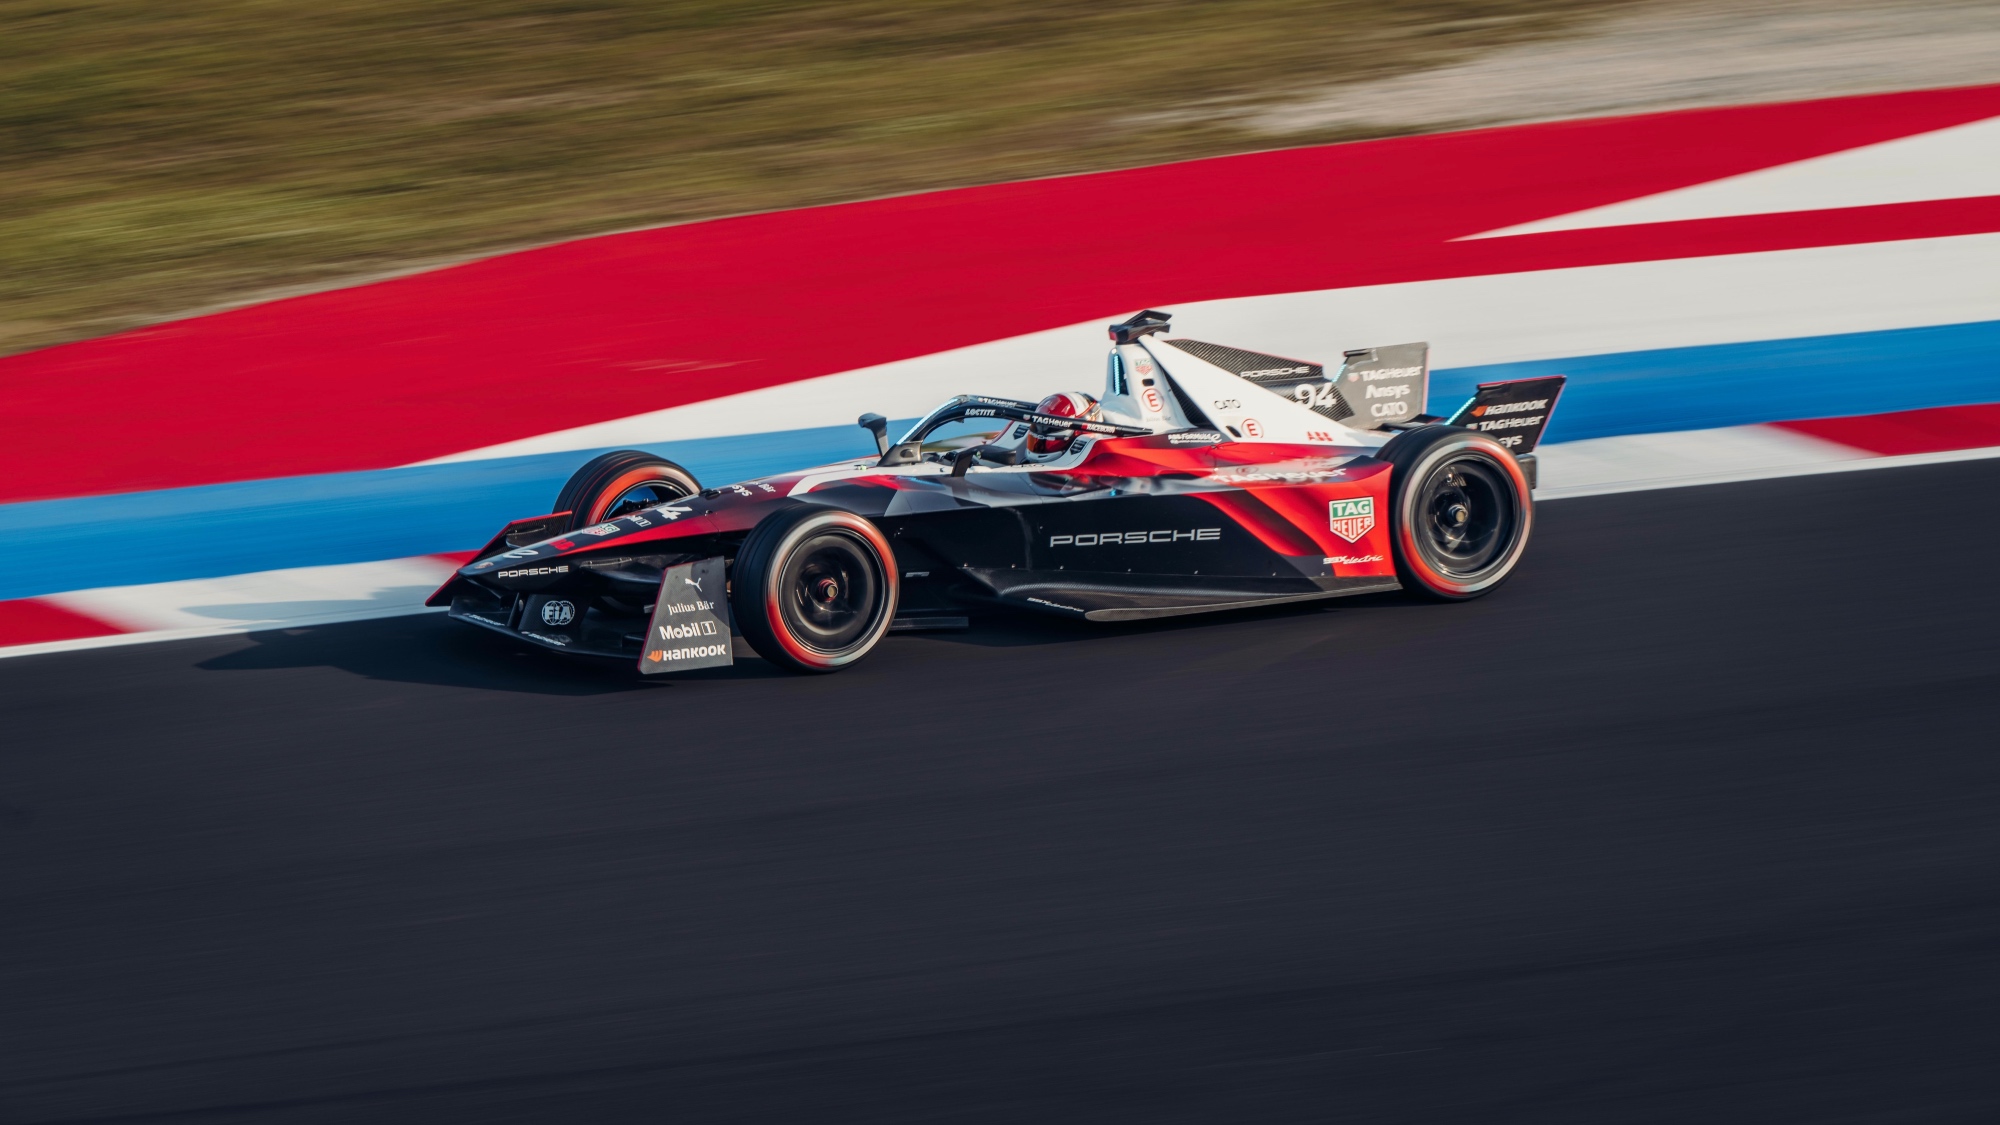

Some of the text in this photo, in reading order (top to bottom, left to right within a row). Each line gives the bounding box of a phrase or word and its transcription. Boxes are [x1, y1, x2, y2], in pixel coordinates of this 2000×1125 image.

[1240, 366, 1309, 378] PORSCHE
[1295, 382, 1336, 410] 94
[1365, 384, 1410, 399] Ansys
[1214, 399, 1241, 410] CATO
[1371, 401, 1408, 417] CATO
[965, 408, 996, 417] LOCTITE
[1307, 432, 1333, 441] ABB
[1333, 501, 1370, 516] TAG
[1333, 517, 1372, 539] HEUER
[1050, 528, 1221, 548] PORSCHE
[498, 565, 569, 579] PORSCHE
[667, 600, 714, 616] Julius Bär
[659, 622, 701, 640] Mobil
